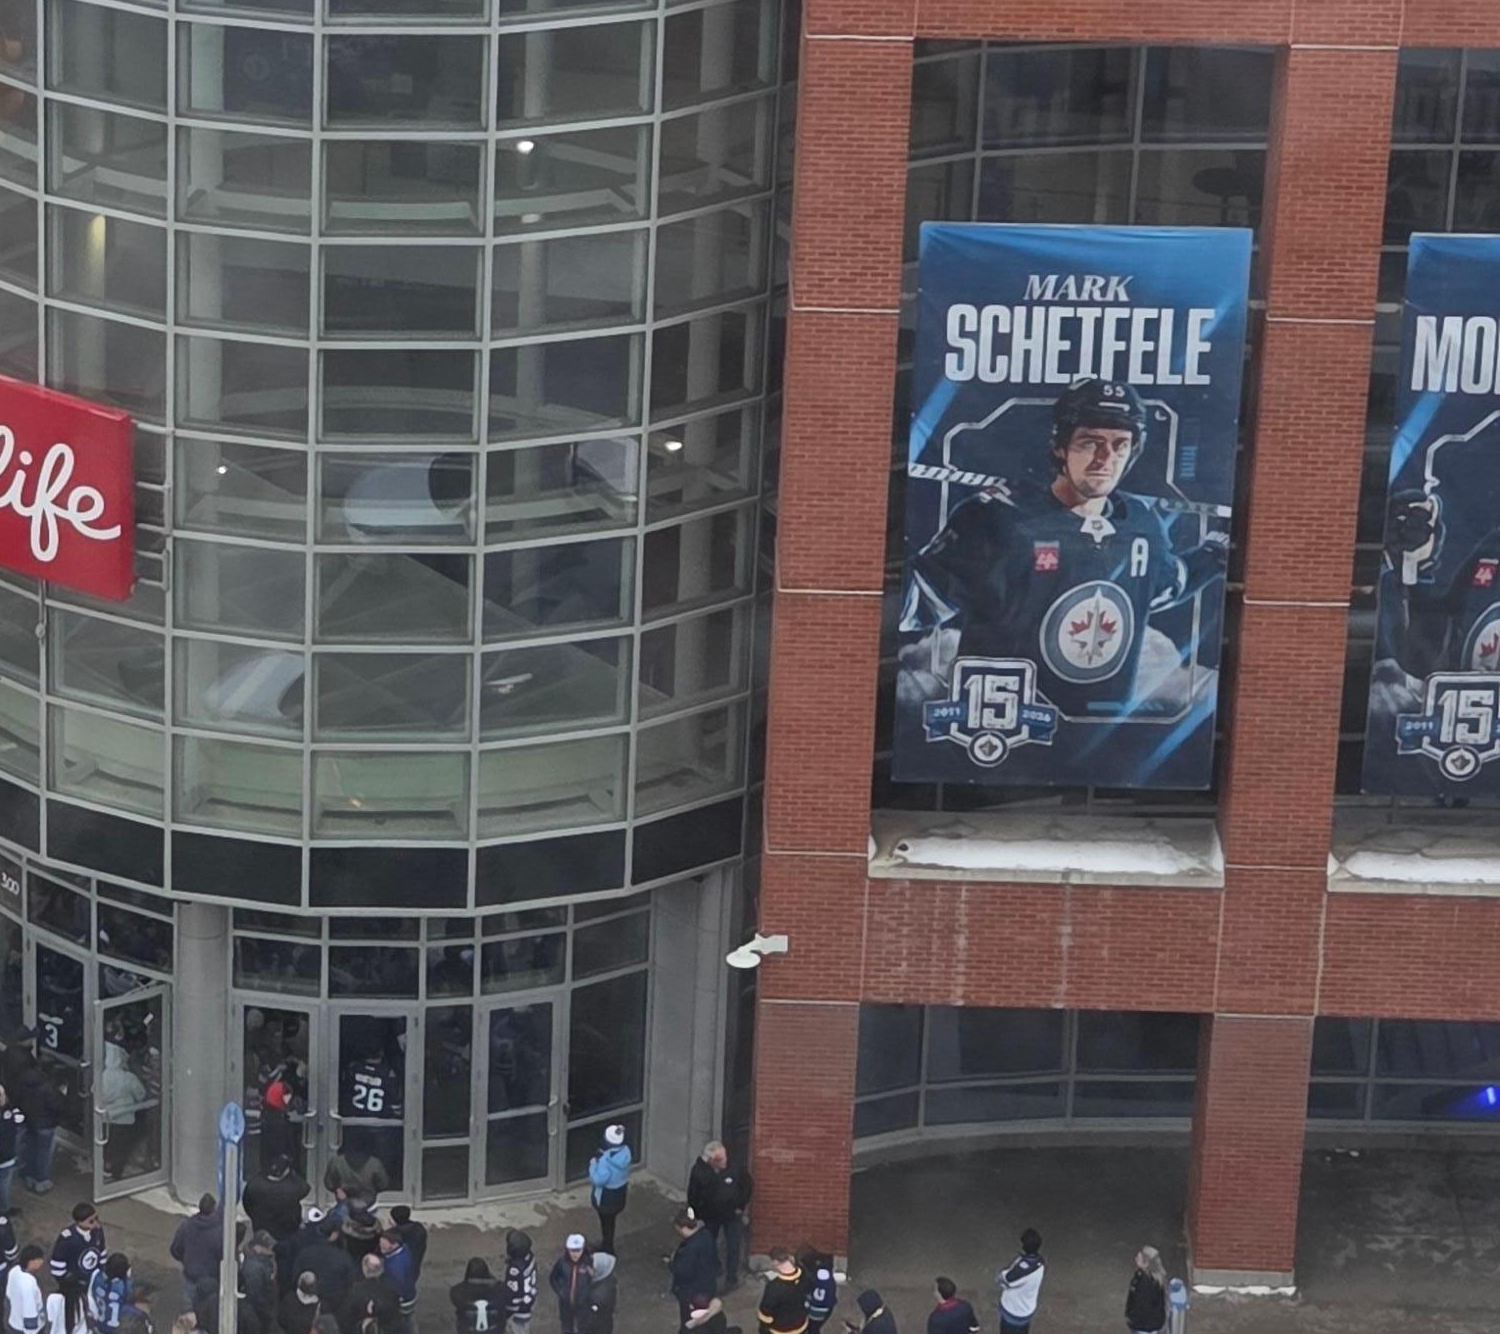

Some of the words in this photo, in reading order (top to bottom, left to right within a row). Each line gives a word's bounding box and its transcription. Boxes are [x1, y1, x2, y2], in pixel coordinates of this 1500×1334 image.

[1023, 274, 1134, 303] MARK
[945, 303, 1217, 385] SCHEIFELE
[1411, 315, 1500, 395] MO
[1130, 536, 1149, 578] A
[963, 674, 1020, 730] 15
[1437, 689, 1495, 745] 15
[352, 1083, 385, 1112] 26
